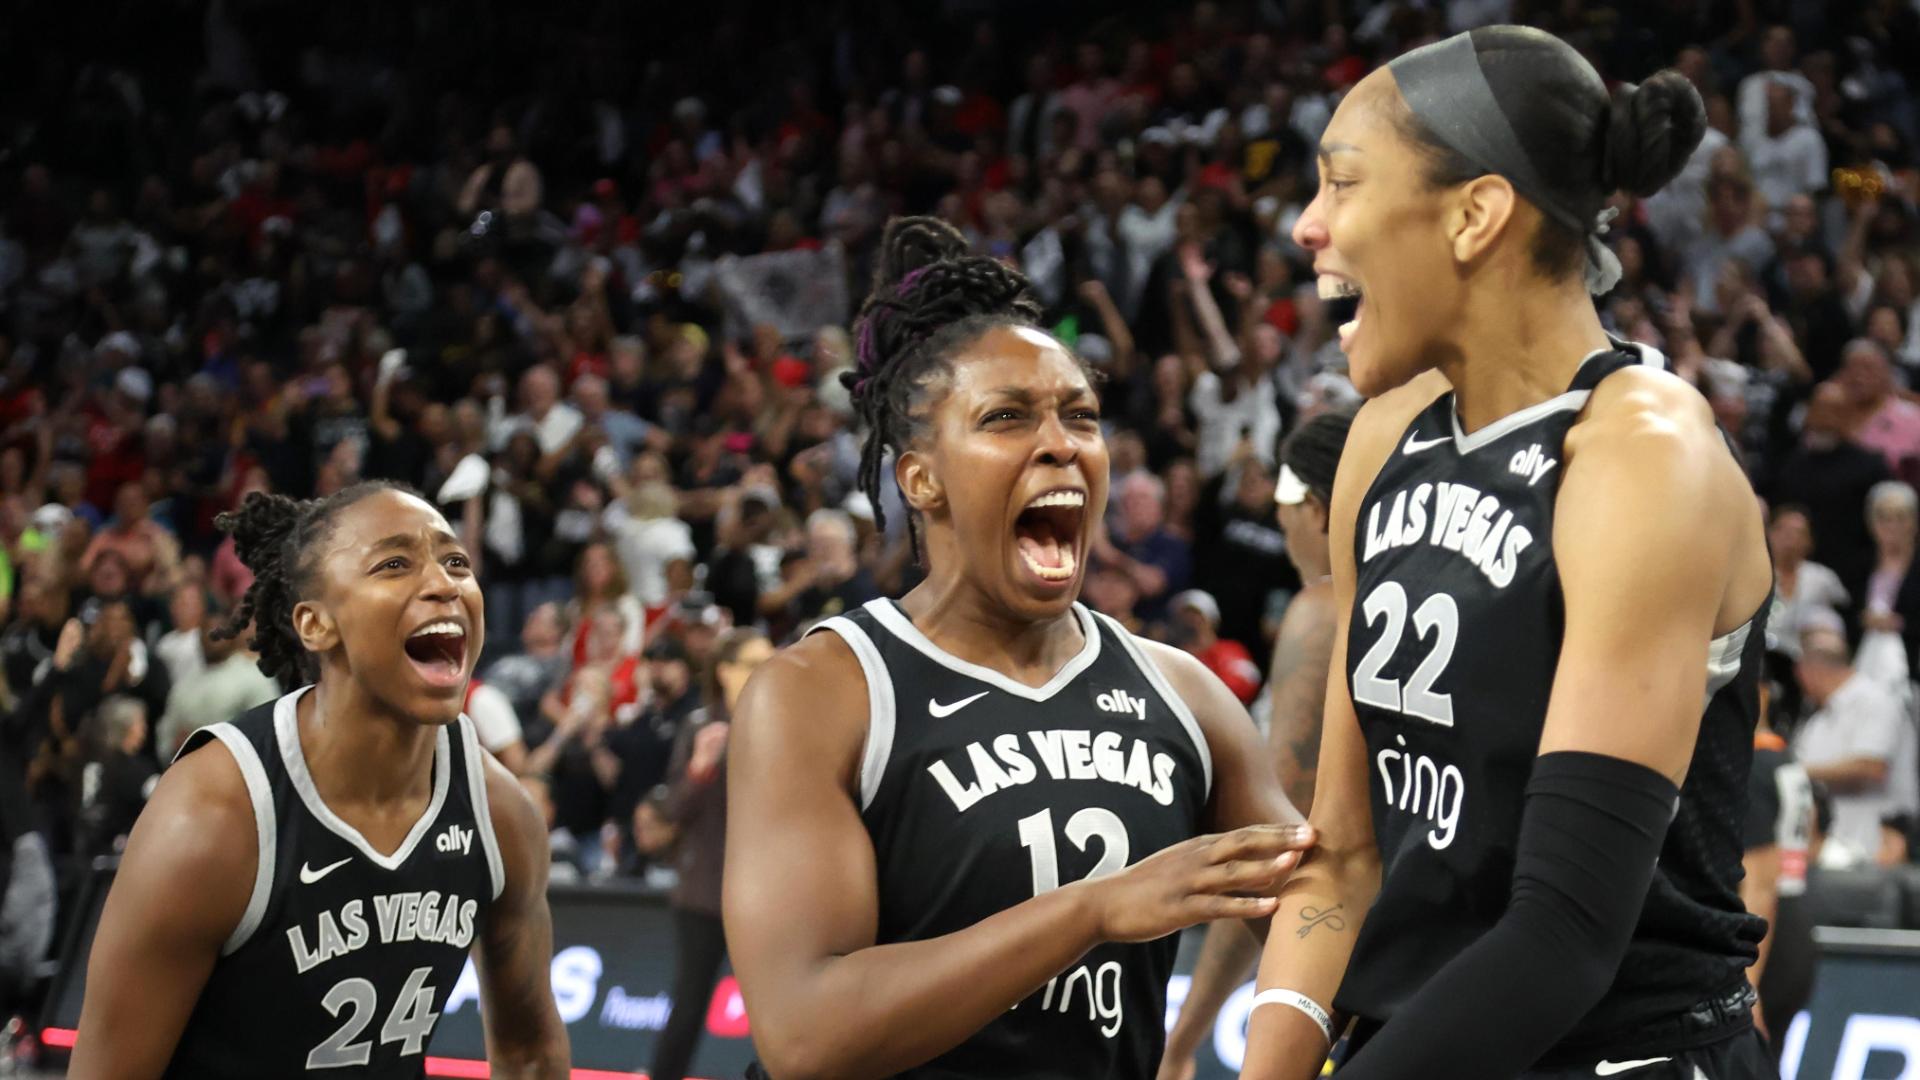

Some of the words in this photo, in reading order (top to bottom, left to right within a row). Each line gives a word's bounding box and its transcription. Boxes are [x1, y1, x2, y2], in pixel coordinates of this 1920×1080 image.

[1508, 443, 1558, 487] ally
[1362, 482, 1434, 564] LAS
[1429, 481, 1534, 588] VEGAS
[1353, 580, 1460, 727] 22
[1095, 688, 1146, 721] ally
[926, 733, 1038, 813] LAS
[1027, 729, 1177, 807] VEGAS
[1376, 733, 1465, 851] ring
[435, 823, 474, 856] ally
[1017, 807, 1130, 899] 12
[286, 898, 370, 975] LAS
[372, 890, 479, 949] VEGAS
[305, 966, 441, 1070] 24
